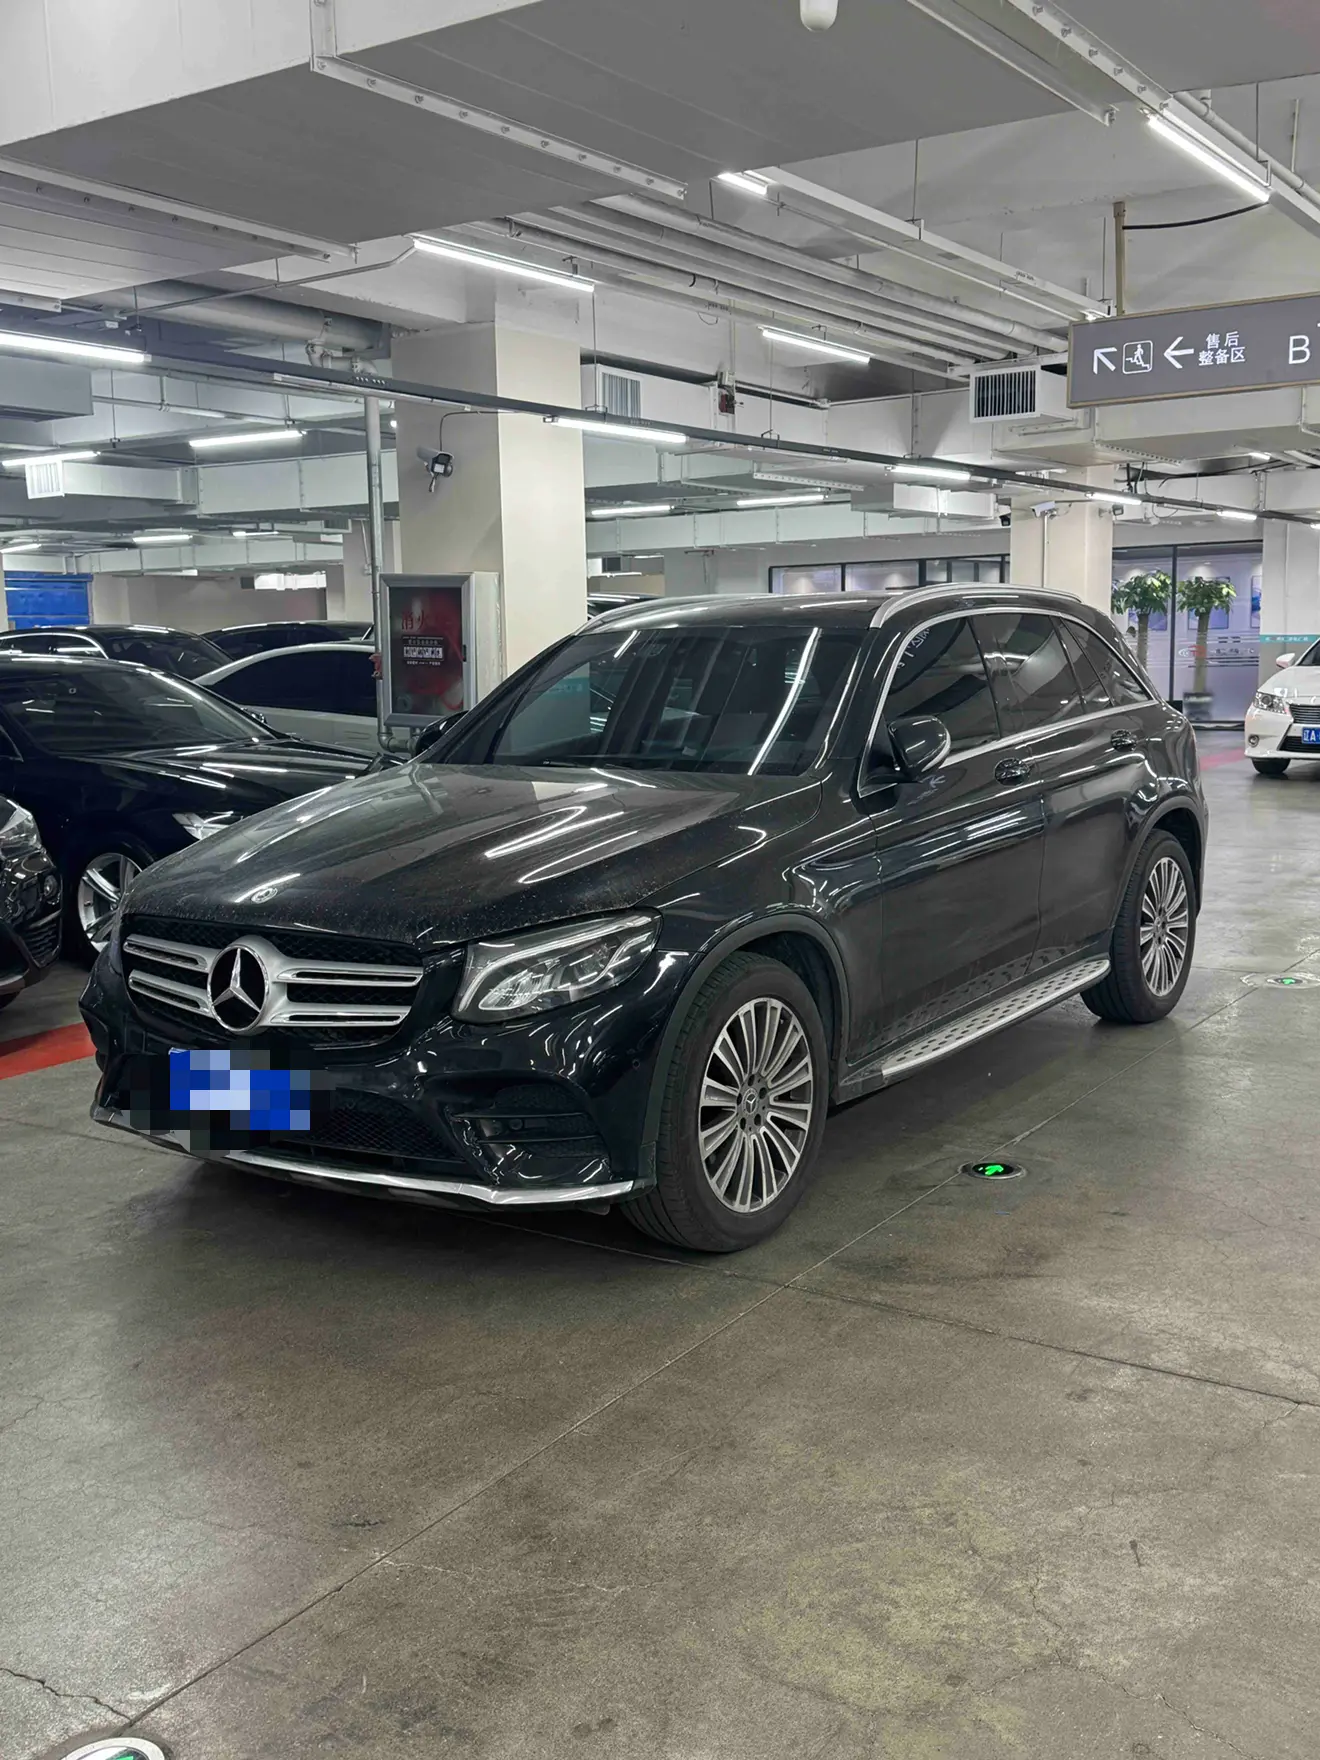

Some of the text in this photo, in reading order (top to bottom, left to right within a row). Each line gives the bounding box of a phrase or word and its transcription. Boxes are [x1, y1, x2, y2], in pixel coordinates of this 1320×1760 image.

[1206, 331, 1239, 349] 售后
[1199, 347, 1245, 366] 整备区
